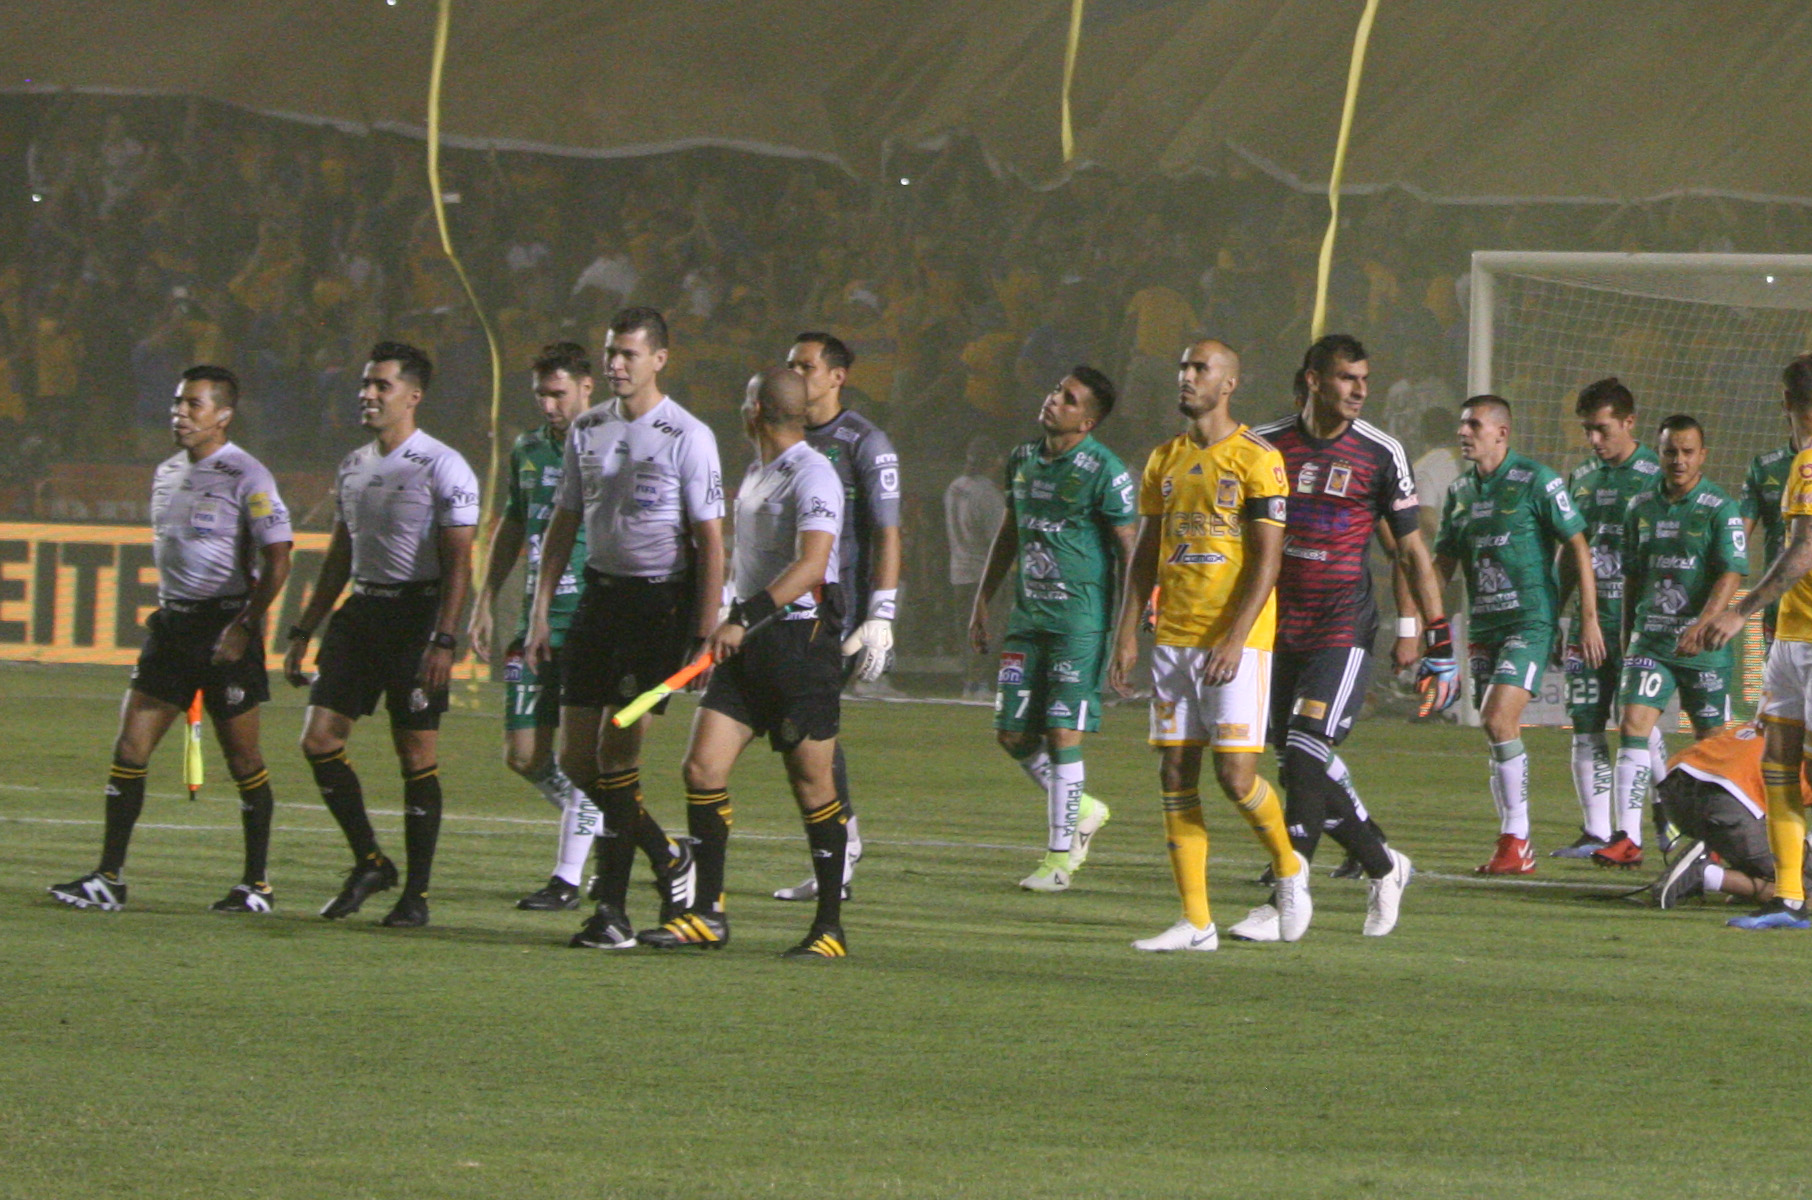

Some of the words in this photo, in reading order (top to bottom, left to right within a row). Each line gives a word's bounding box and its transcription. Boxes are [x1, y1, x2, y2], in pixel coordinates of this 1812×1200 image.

[1572, 678, 1600, 704] 23
[1637, 670, 1662, 698] 10
[1014, 689, 1031, 719] 7
